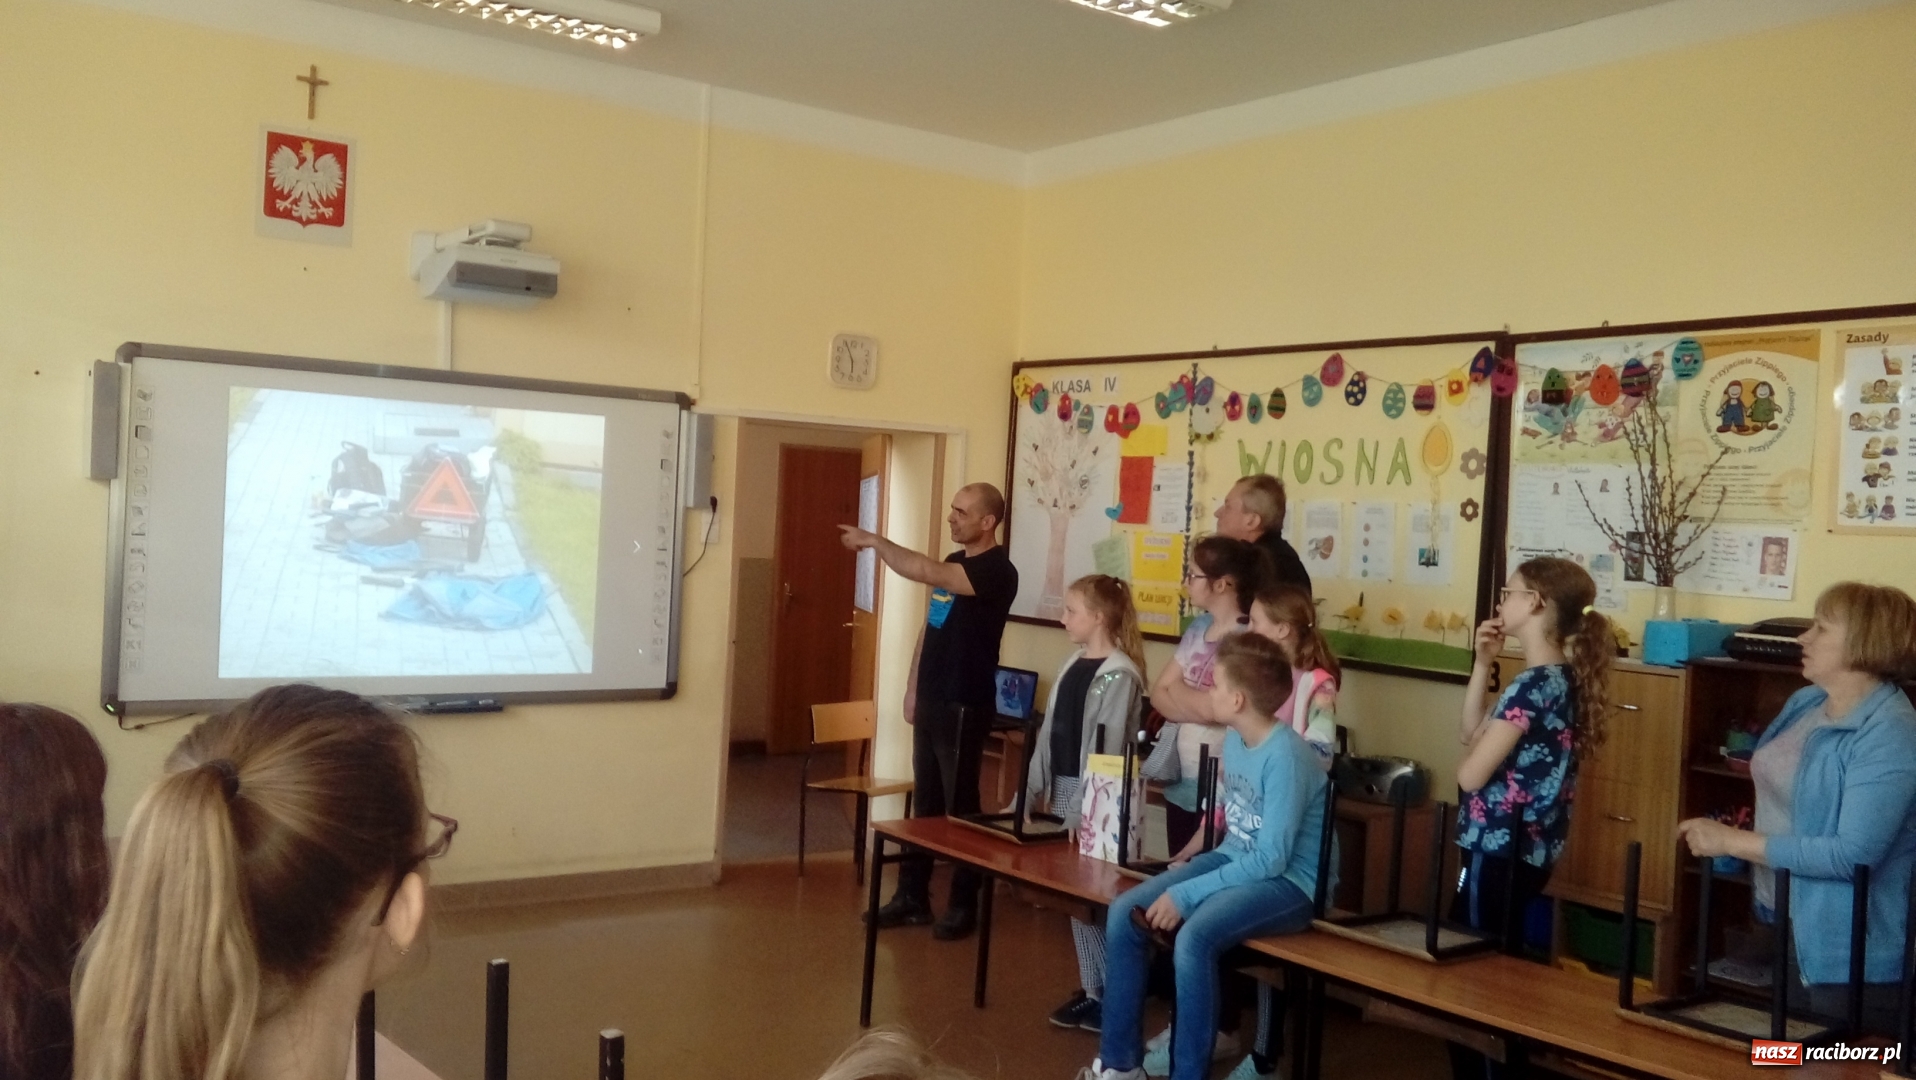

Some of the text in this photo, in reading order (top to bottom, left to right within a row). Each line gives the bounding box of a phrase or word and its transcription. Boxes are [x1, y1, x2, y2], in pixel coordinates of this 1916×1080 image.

[1846, 331, 1889, 344] Zasady
[1709, 357, 1787, 384] Przyjaciele Zippiego
[1052, 376, 1117, 394] KLASA IV
[1237, 437, 1412, 486] WIOSNA
